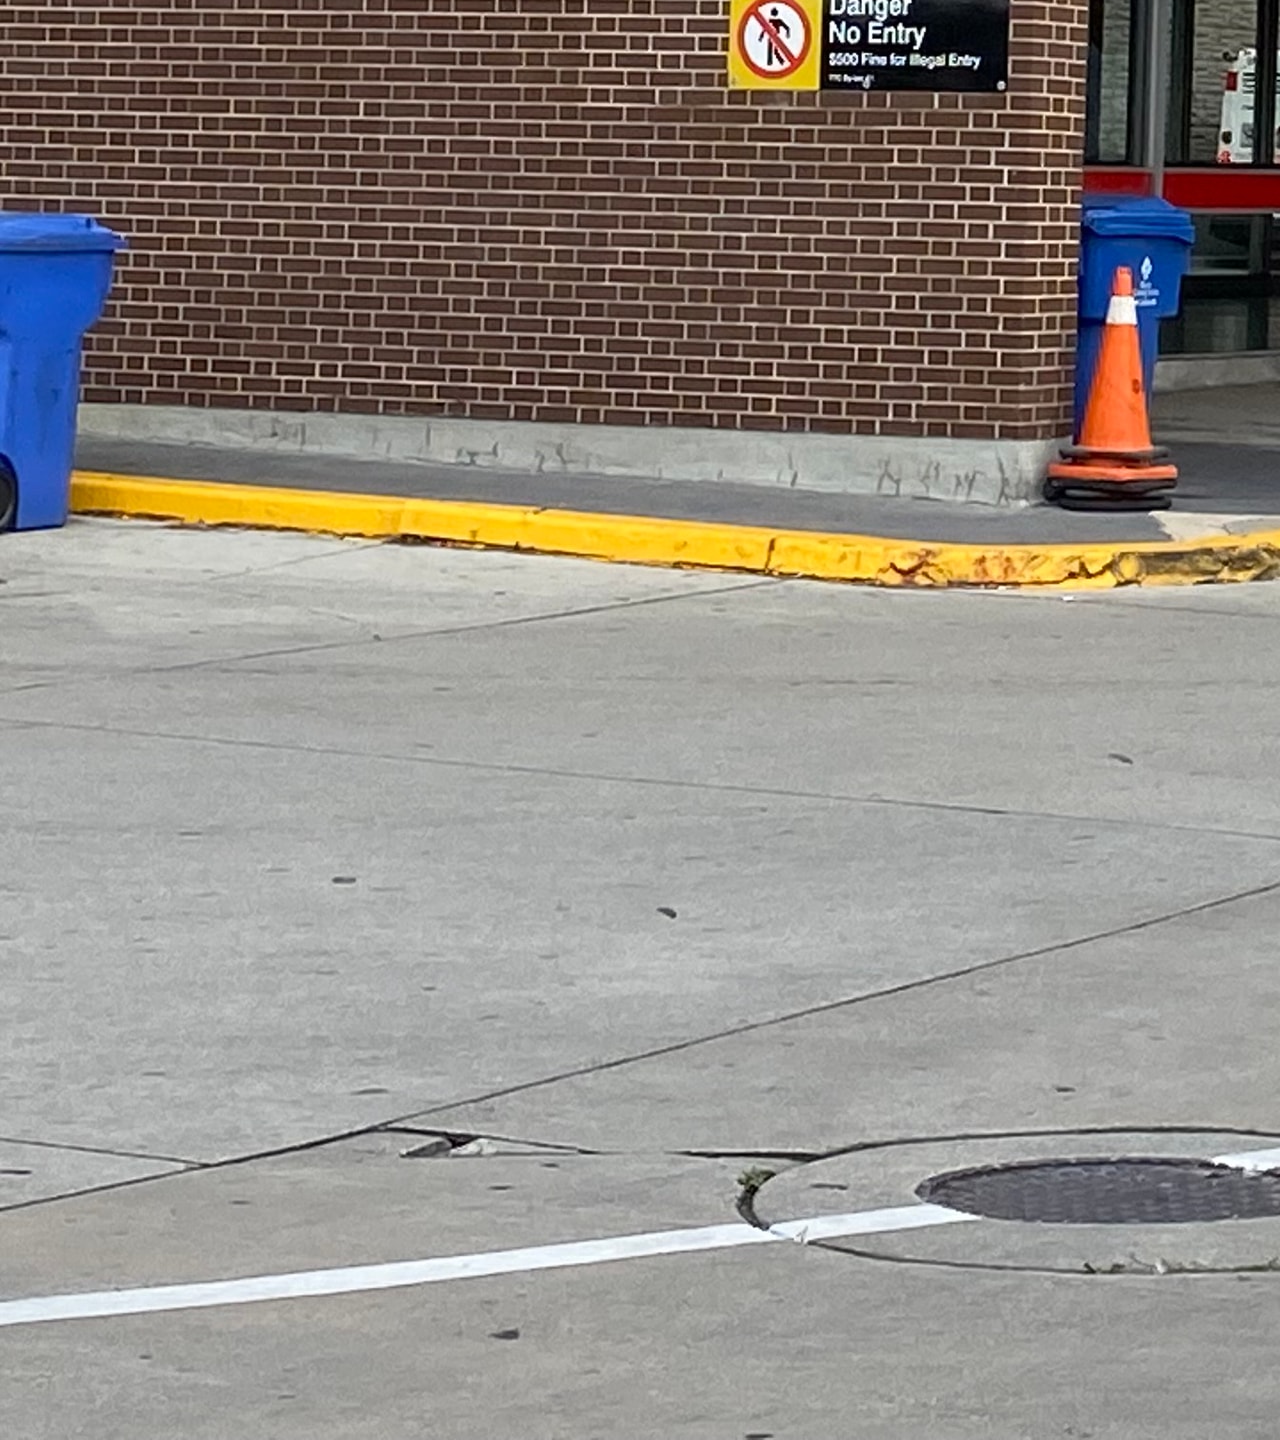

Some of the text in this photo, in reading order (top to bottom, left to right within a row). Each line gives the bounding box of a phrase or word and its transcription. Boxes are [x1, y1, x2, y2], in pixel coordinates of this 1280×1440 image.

[828, 21, 926, 49] No Entry
[861, 52, 888, 67] Fine
[889, 52, 907, 67] for
[909, 52, 946, 70] Illegal
[948, 53, 982, 71] Entry
